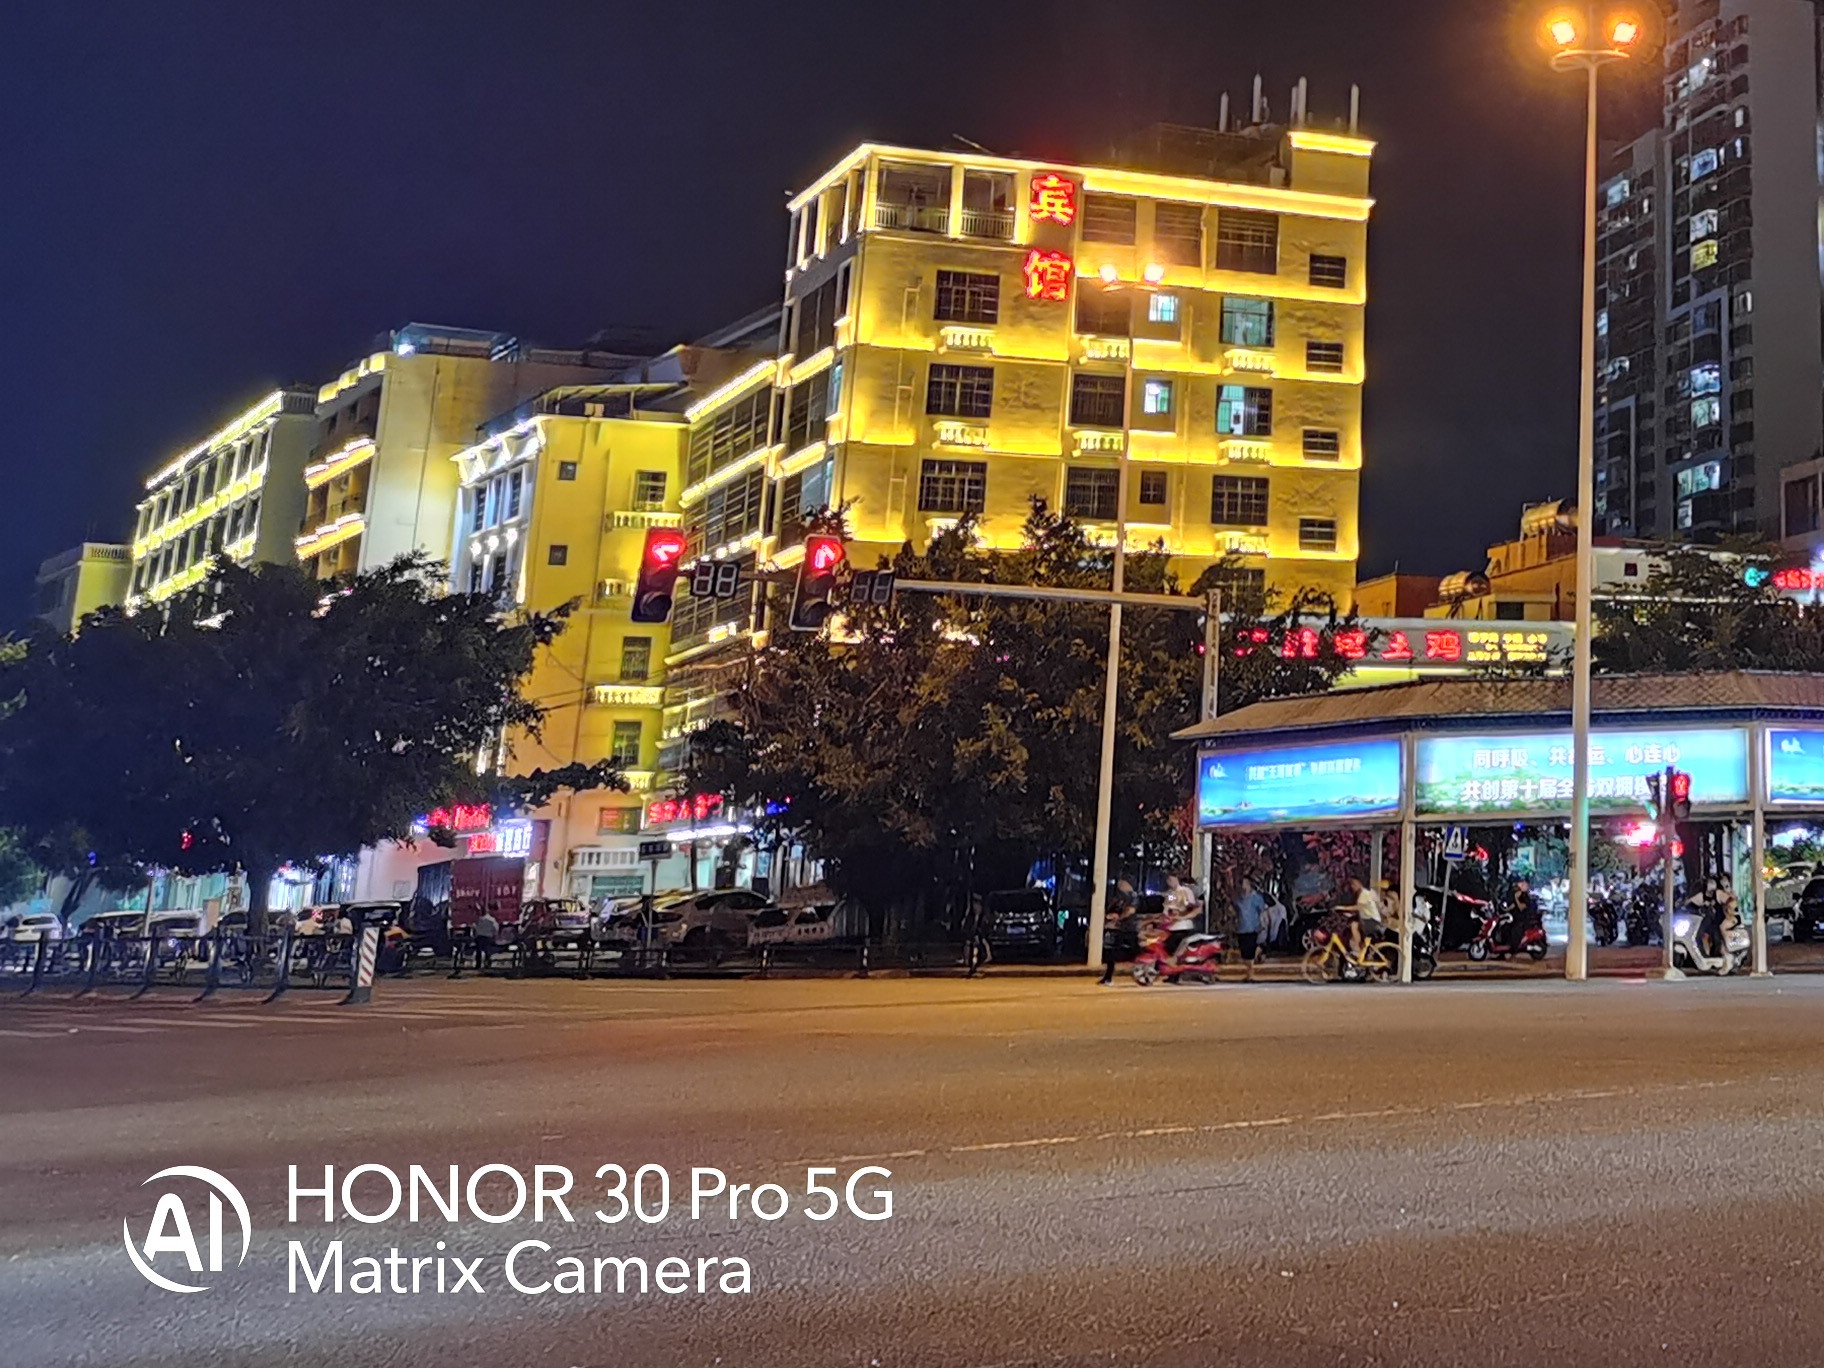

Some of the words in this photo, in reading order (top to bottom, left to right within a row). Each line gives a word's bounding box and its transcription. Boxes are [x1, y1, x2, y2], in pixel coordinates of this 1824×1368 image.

[1025, 173, 1077, 301] 宾馆
[1472, 743, 1682, 769] 同呼吸、共运、心连心
